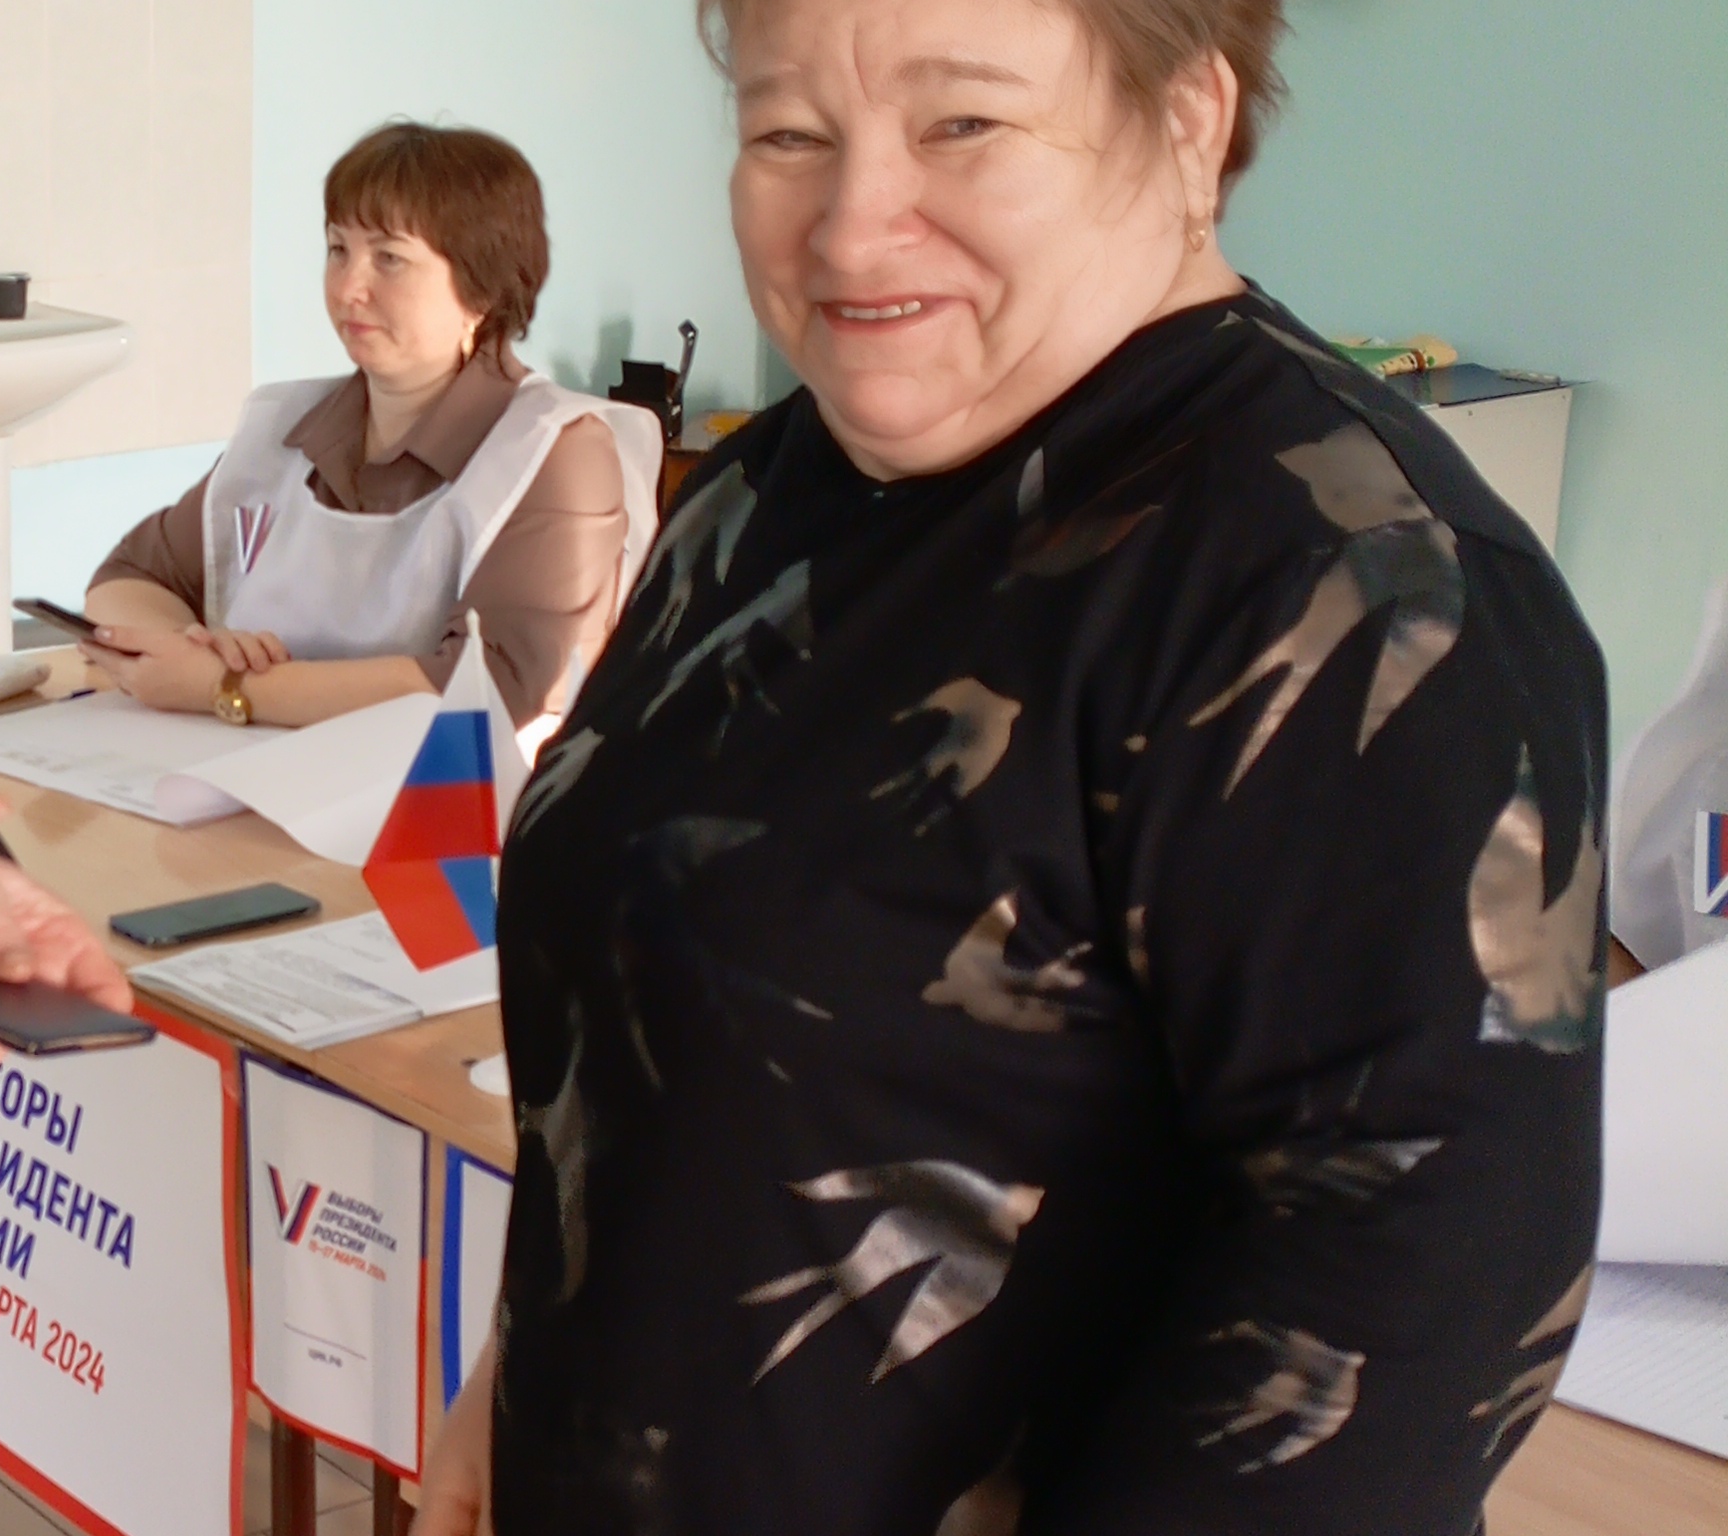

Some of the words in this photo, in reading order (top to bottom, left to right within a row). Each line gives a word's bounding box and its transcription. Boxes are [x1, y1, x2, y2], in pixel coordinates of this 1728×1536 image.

[327, 1190, 384, 1224] ВЫБОРЫ
[313, 1224, 367, 1254] РОССИИ
[319, 1208, 398, 1252] ПРЕЗИДЕНТА
[41, 1319, 105, 1395] 2024
